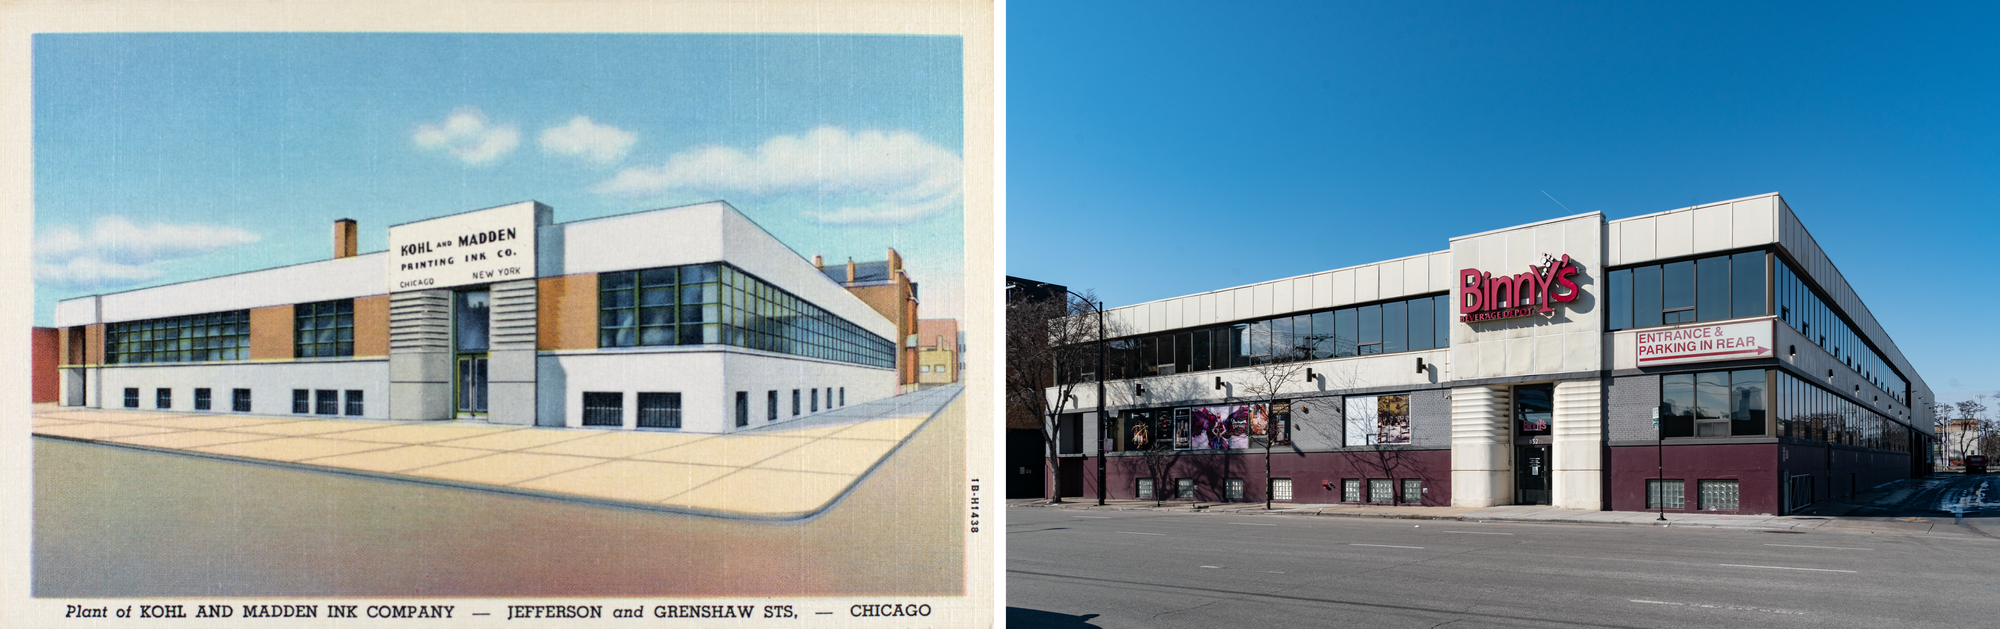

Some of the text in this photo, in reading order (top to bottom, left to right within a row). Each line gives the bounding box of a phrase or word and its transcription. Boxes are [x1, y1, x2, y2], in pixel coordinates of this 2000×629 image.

[401, 241, 433, 257] KOHL
[458, 227, 516, 247] MADDEN
[401, 248, 517, 271] PRINTING INK CO.
[400, 266, 521, 288] CHICAGO NEW YORK
[1459, 307, 1535, 323] BEVERAGE DEPOT
[1639, 325, 1724, 344] ENTRANCE &
[1639, 336, 1756, 356] PARKING IN REAR
[970, 478, 980, 533] 1B-H1438
[65, 604, 108, 618] Plant
[116, 604, 132, 618] of
[140, 604, 187, 618] KOHL
[195, 604, 234, 618] AND
[242, 604, 318, 618] MADDEN
[327, 605, 358, 618] INK
[366, 605, 455, 619] COMPANY
[507, 605, 603, 621] JEFFERSON
[612, 605, 644, 618] and
[654, 605, 755, 619] GRENSHAW
[850, 603, 932, 617] CHICAGO
